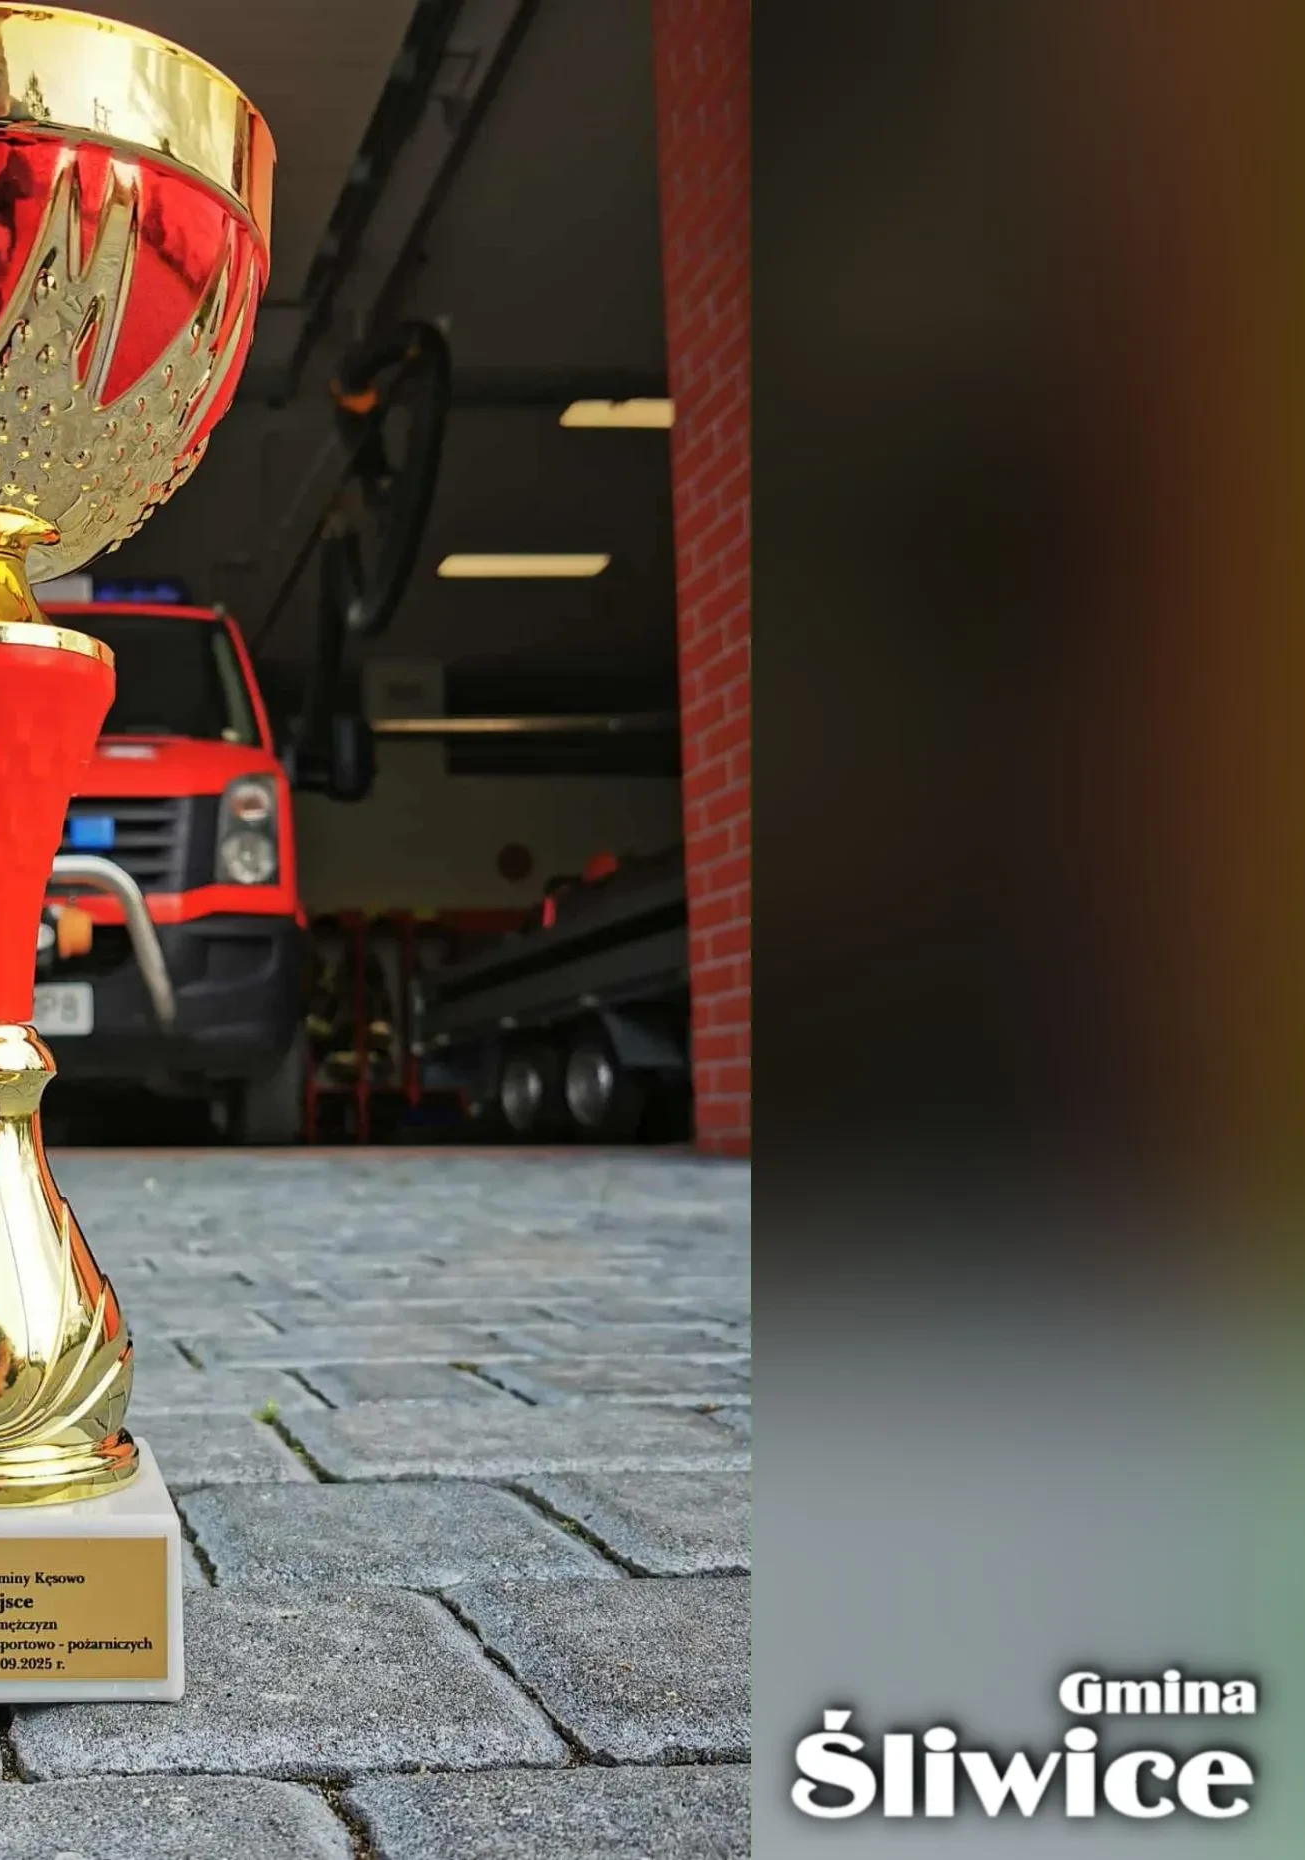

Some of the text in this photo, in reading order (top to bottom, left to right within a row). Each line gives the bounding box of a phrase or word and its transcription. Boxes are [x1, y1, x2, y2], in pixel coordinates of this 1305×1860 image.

[34, 1571, 86, 1588] Kęsowo
[67, 1637, 153, 1655] pożarniczych
[56, 1660, 66, 1671] r.
